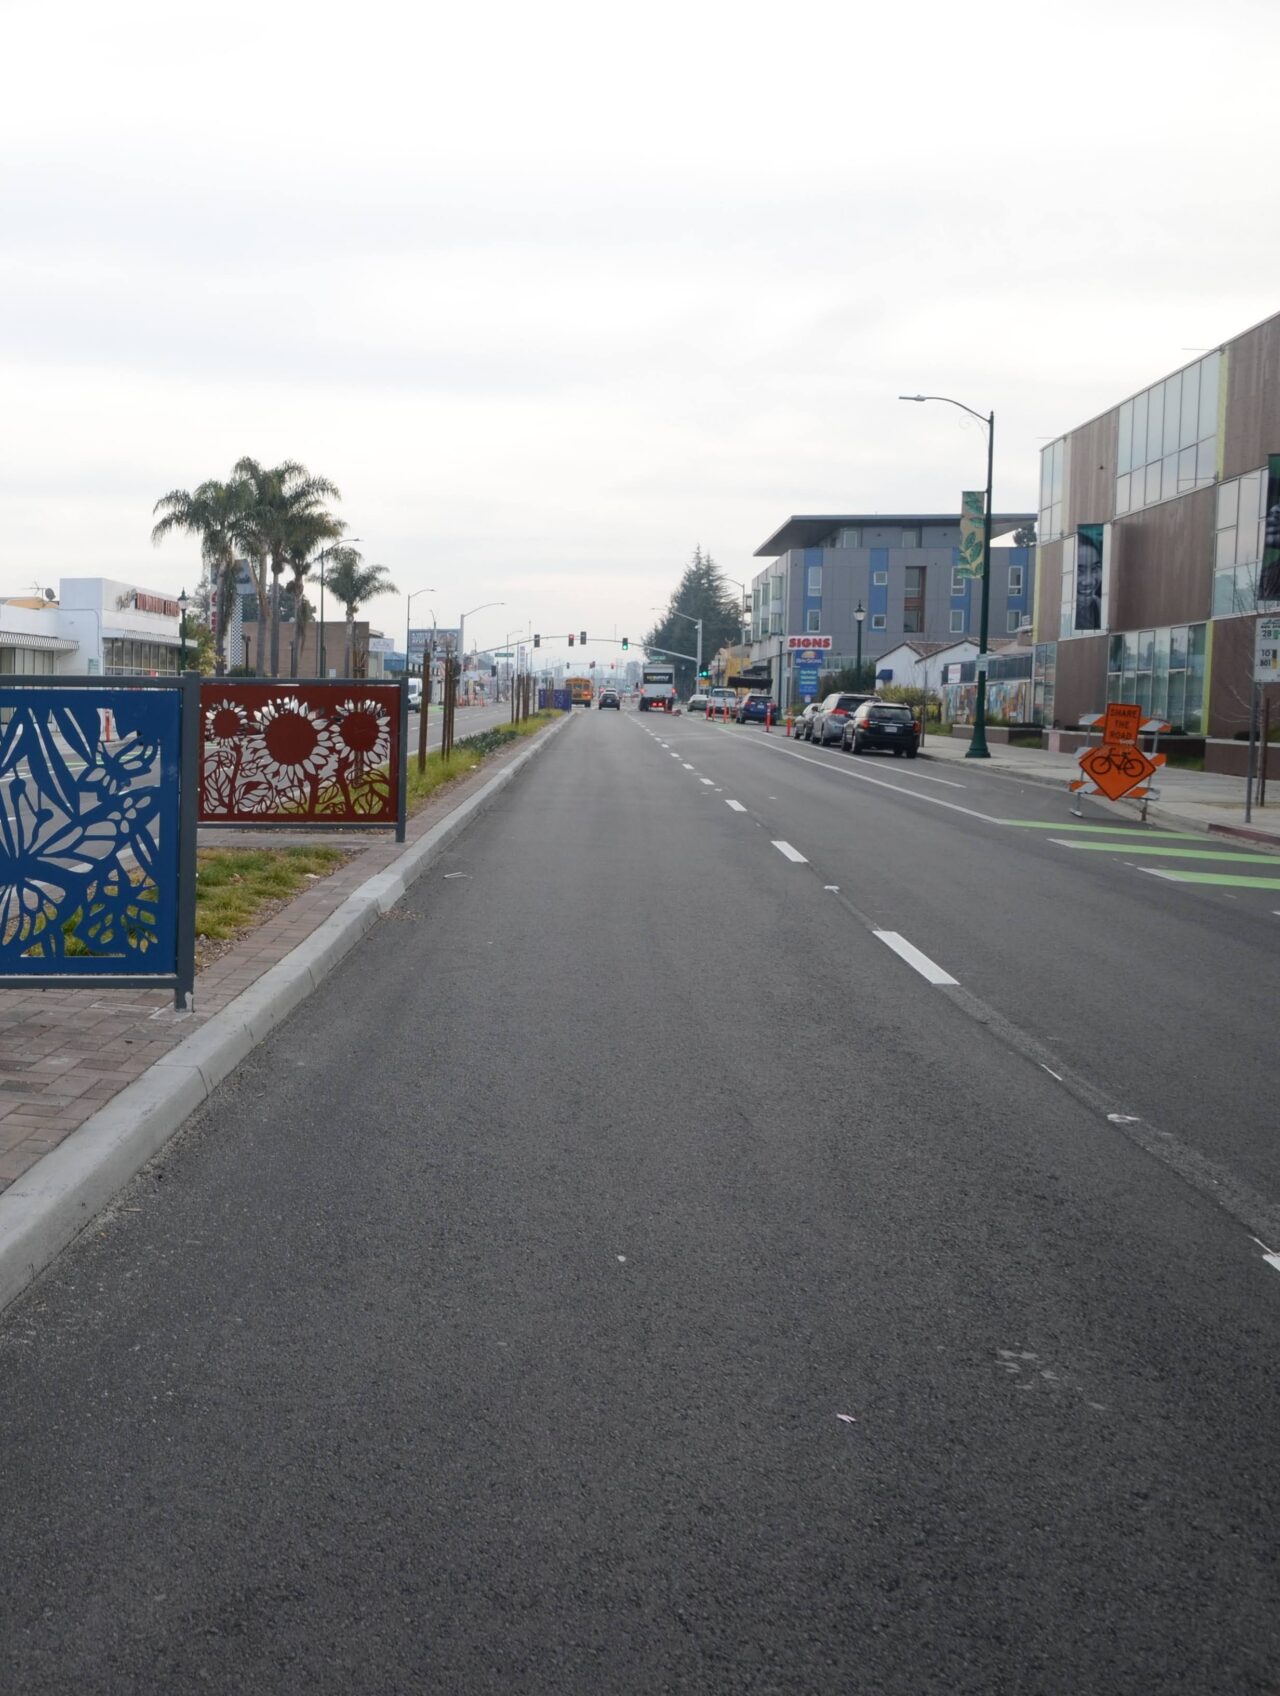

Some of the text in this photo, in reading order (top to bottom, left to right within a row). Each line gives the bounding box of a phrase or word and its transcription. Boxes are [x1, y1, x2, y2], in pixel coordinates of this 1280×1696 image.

[1261, 629, 1272, 638] 28
[789, 638, 831, 648] SIGNS
[1110, 709, 1137, 718] SHARE
[1115, 720, 1130, 728] THE
[1109, 731, 1133, 739] ROAD
